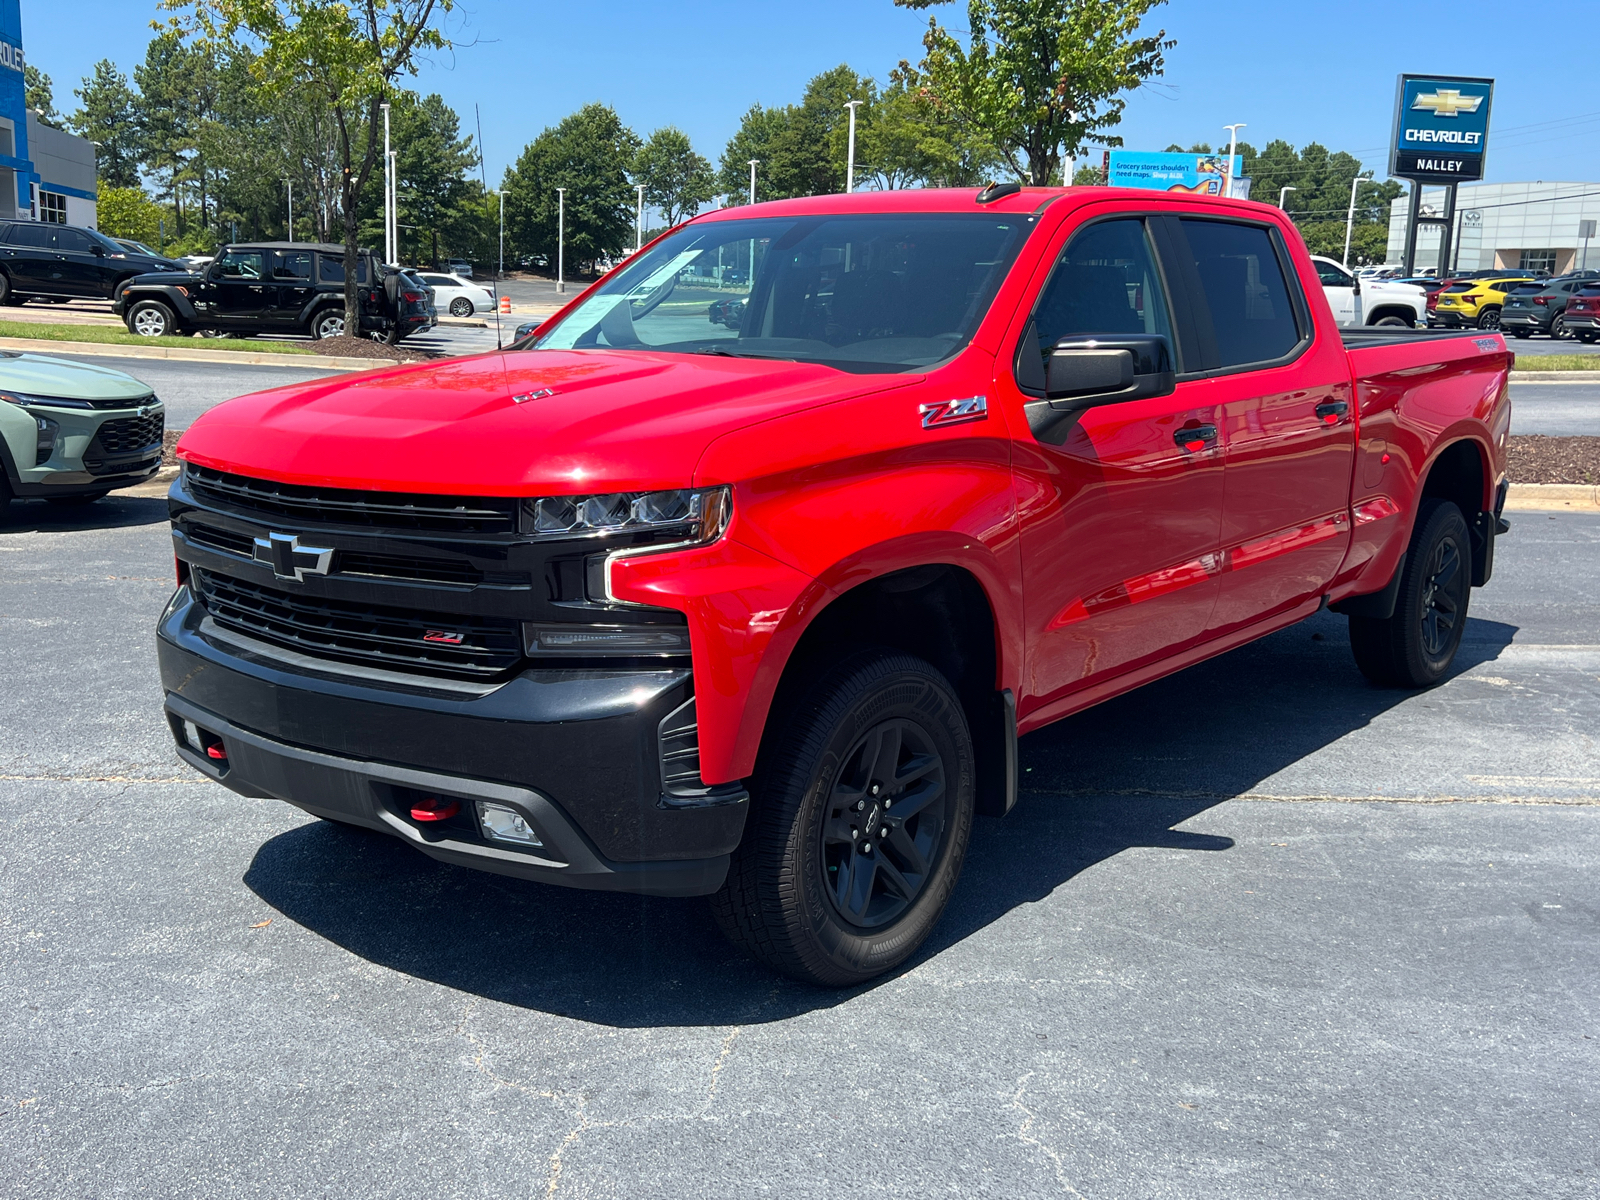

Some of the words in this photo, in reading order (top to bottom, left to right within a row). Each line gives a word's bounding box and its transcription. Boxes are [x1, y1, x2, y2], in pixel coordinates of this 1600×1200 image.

[1405, 129, 1482, 145] CHEVROLET
[1116, 162, 1140, 172] Grocery
[1140, 163, 1160, 171] stores
[1160, 164, 1190, 172] shouldn't
[1416, 158, 1463, 172] NALLEY
[1115, 170, 1132, 178] need
[1132, 172, 1152, 180] maps.
[917, 395, 988, 428] Z71
[423, 630, 466, 644] Z71
